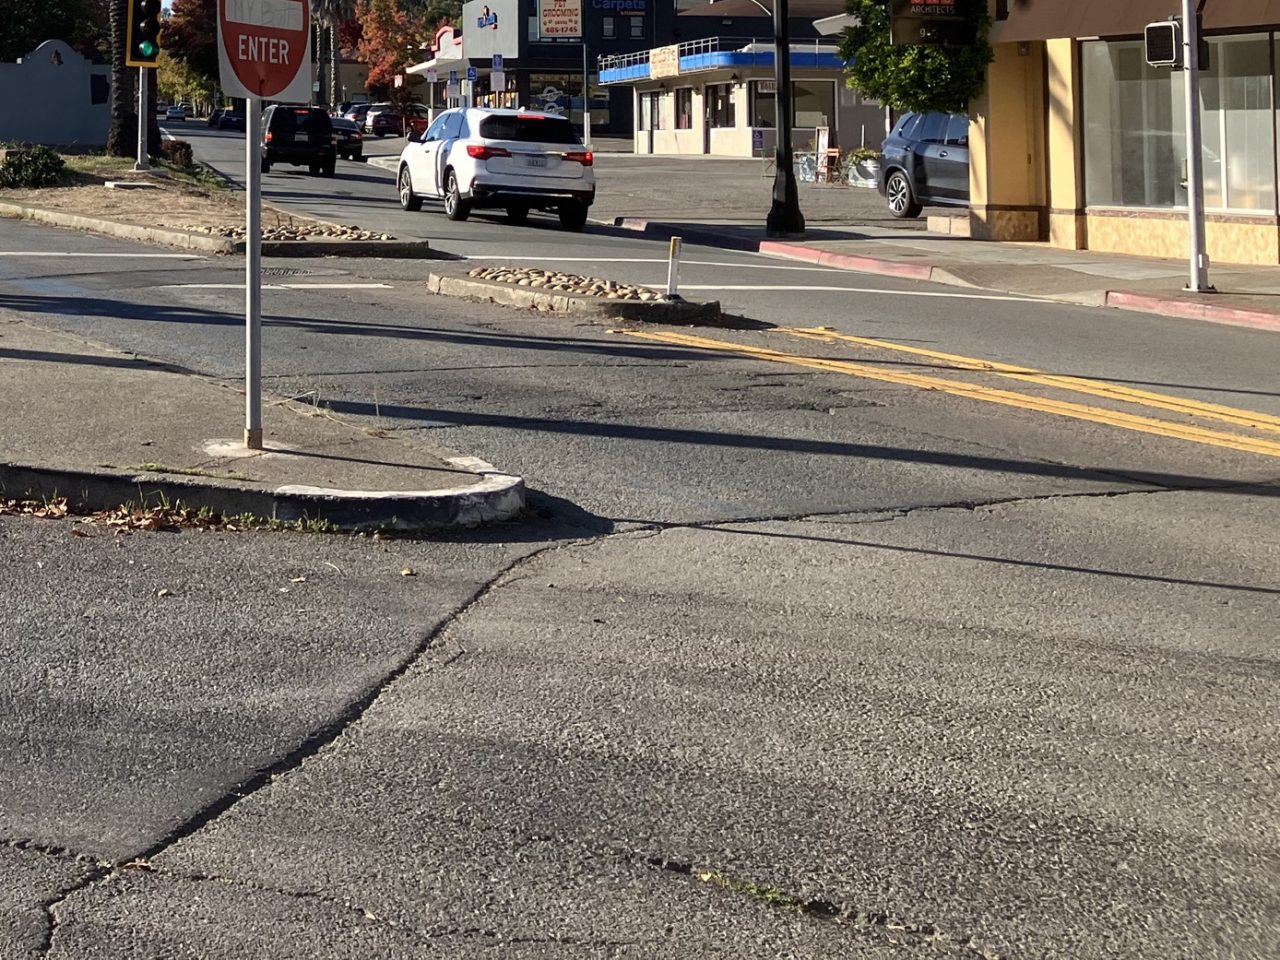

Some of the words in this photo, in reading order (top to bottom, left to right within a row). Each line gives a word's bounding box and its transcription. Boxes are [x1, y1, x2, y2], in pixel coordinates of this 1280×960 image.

[554, 0, 567, 7] PET
[543, 8, 578, 17] GROOMING
[910, 5, 955, 14] ARCHITECTS
[239, 34, 289, 65] ENTER
